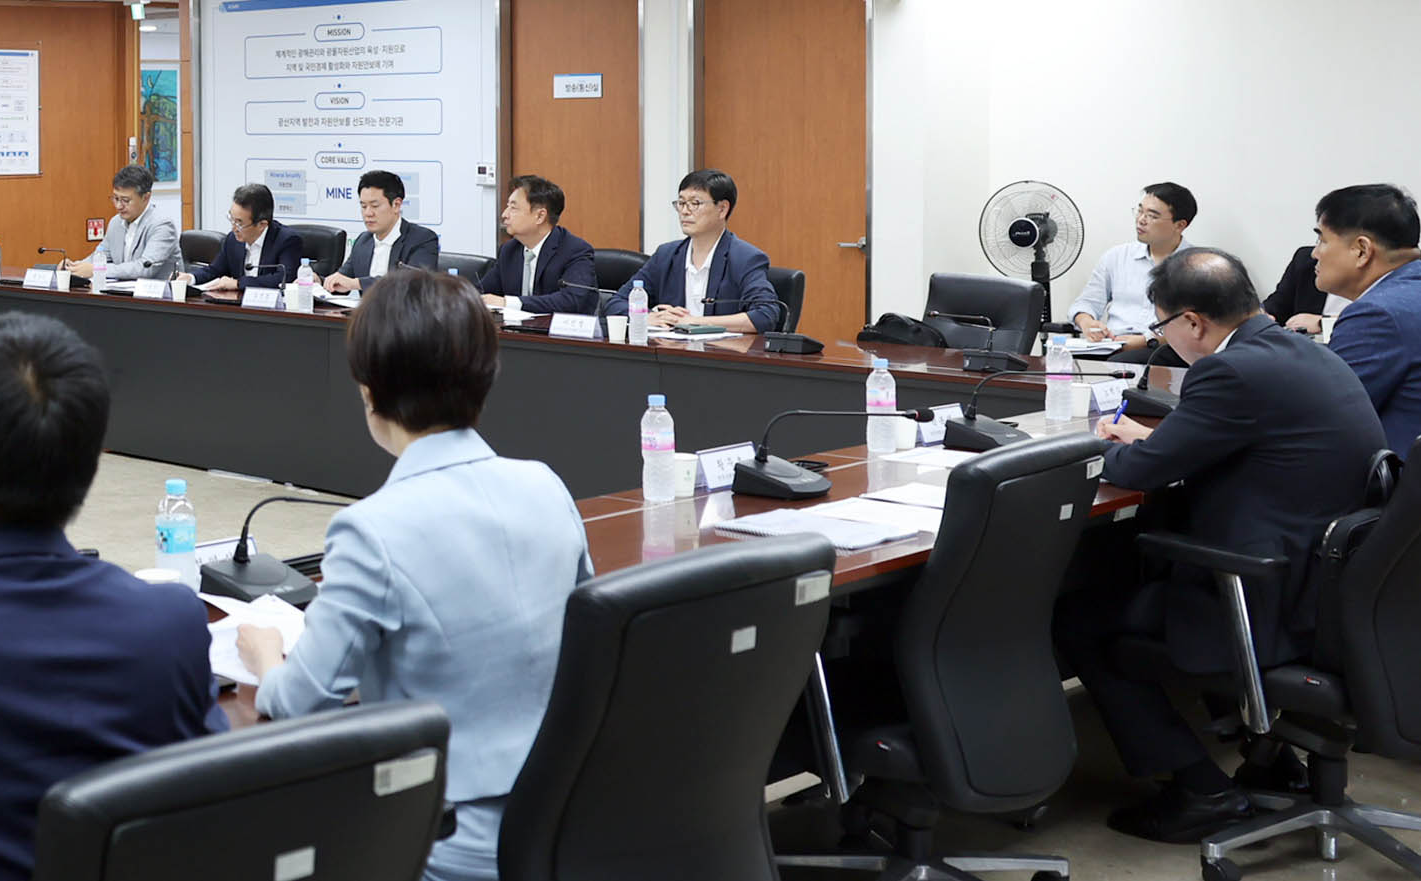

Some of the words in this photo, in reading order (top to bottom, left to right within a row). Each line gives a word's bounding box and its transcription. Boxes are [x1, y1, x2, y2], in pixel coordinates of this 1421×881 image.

[327, 28, 351, 37] MISSION
[329, 97, 350, 105] VISION
[320, 156, 336, 165] CORE
[337, 156, 359, 165] VALUES
[325, 187, 353, 200] MINE
